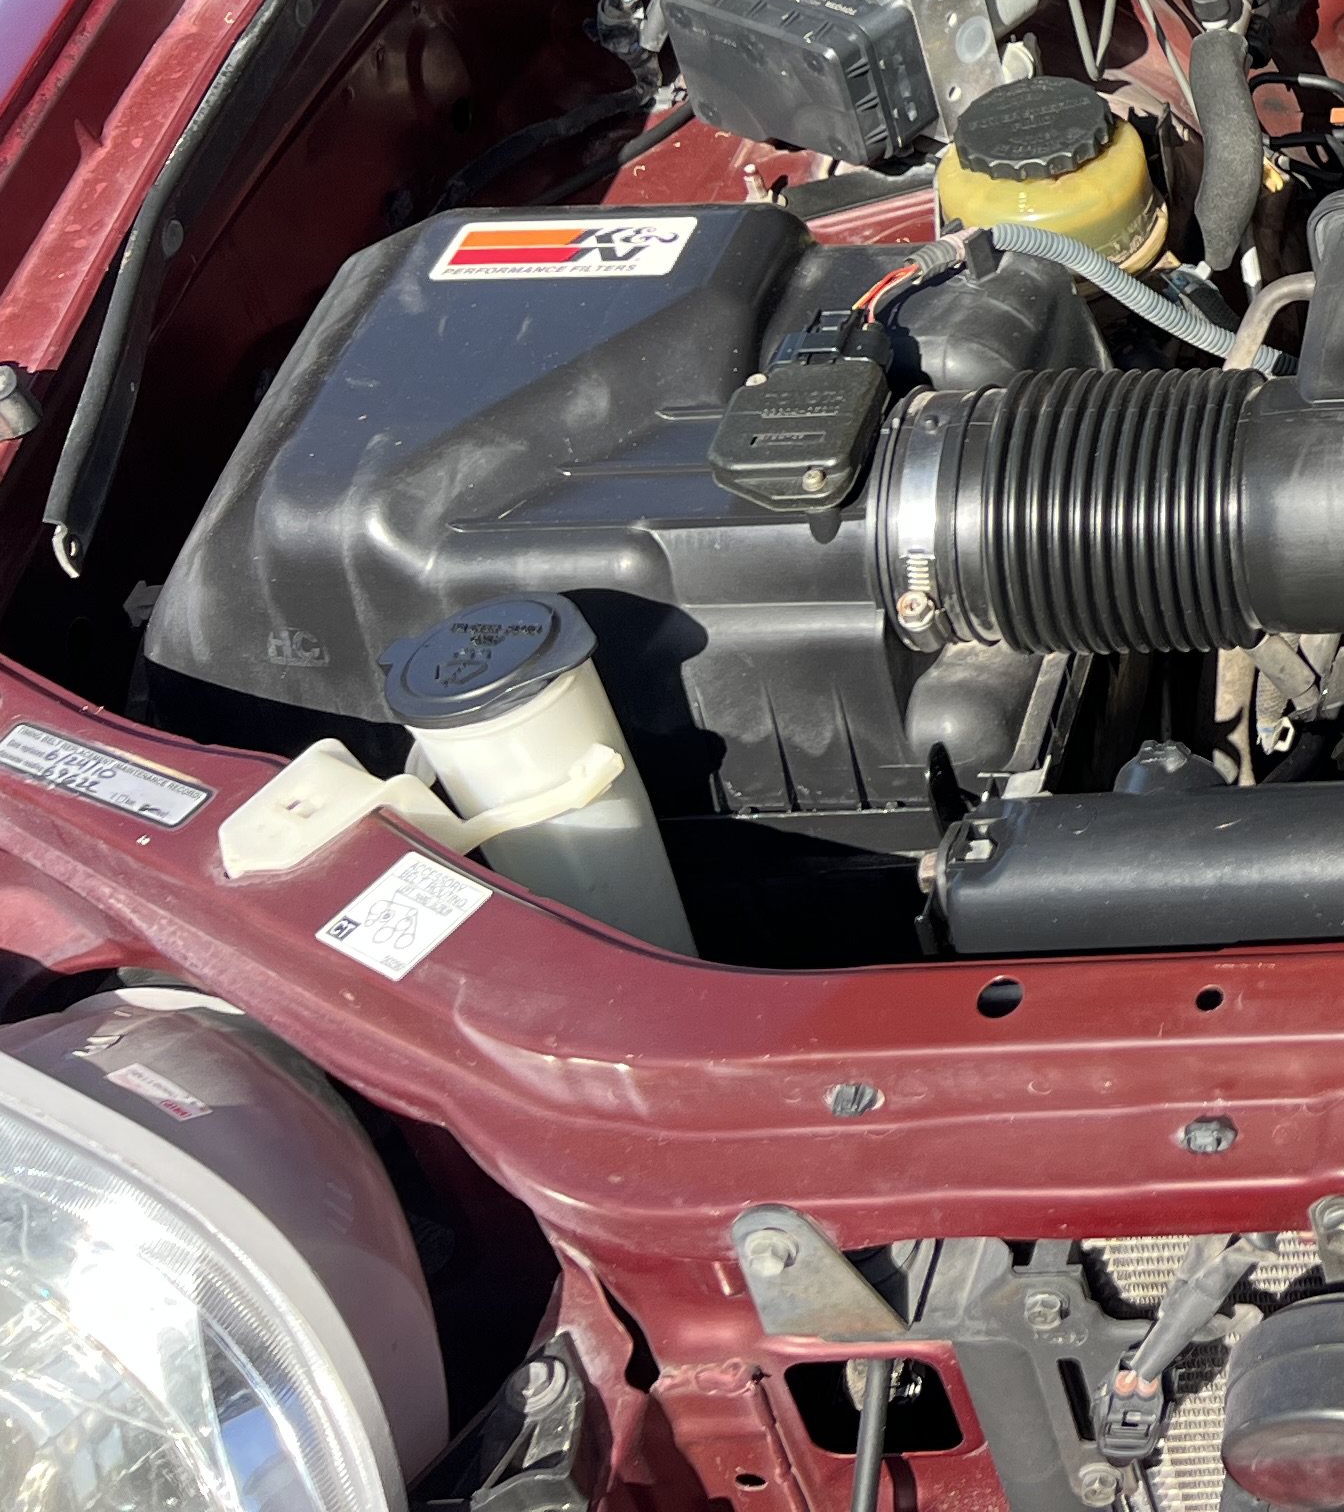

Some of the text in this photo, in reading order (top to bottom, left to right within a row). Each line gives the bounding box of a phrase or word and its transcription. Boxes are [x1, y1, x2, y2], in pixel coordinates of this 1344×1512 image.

[441, 263, 639, 276] PERFORMANCE FILTERS
[410, 861, 468, 892] ACCESSORY
